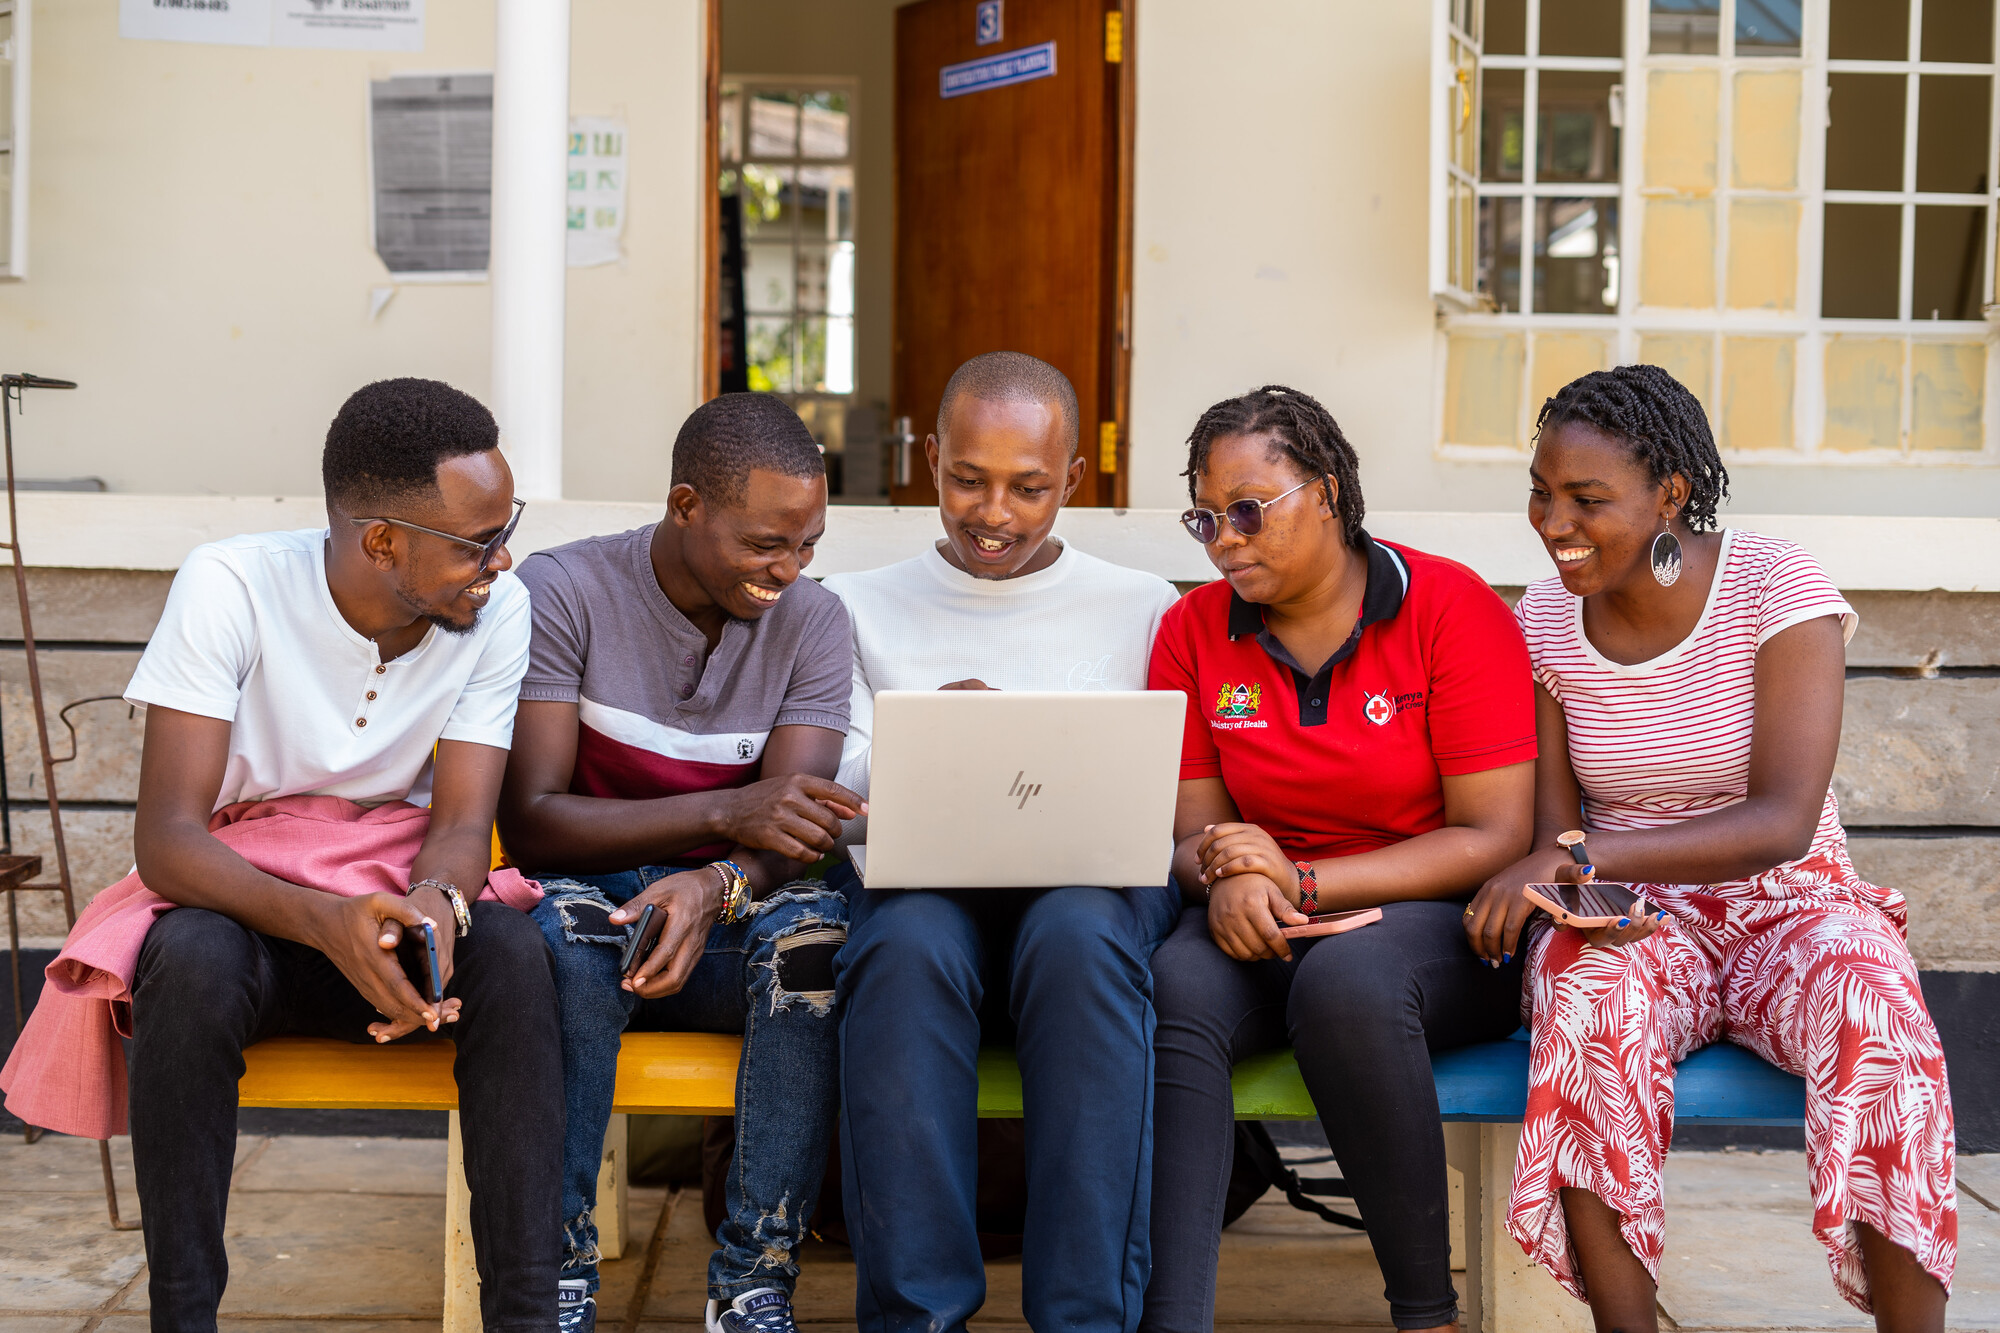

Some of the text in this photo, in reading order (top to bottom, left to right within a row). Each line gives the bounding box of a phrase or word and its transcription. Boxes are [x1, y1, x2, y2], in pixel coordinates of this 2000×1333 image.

[981, 7, 996, 38] 3
[1394, 691, 1423, 705] Kenya
[1404, 700, 1424, 710] Cross
[1210, 719, 1268, 731] Mnistry of Health
[1008, 770, 1042, 810] hp
